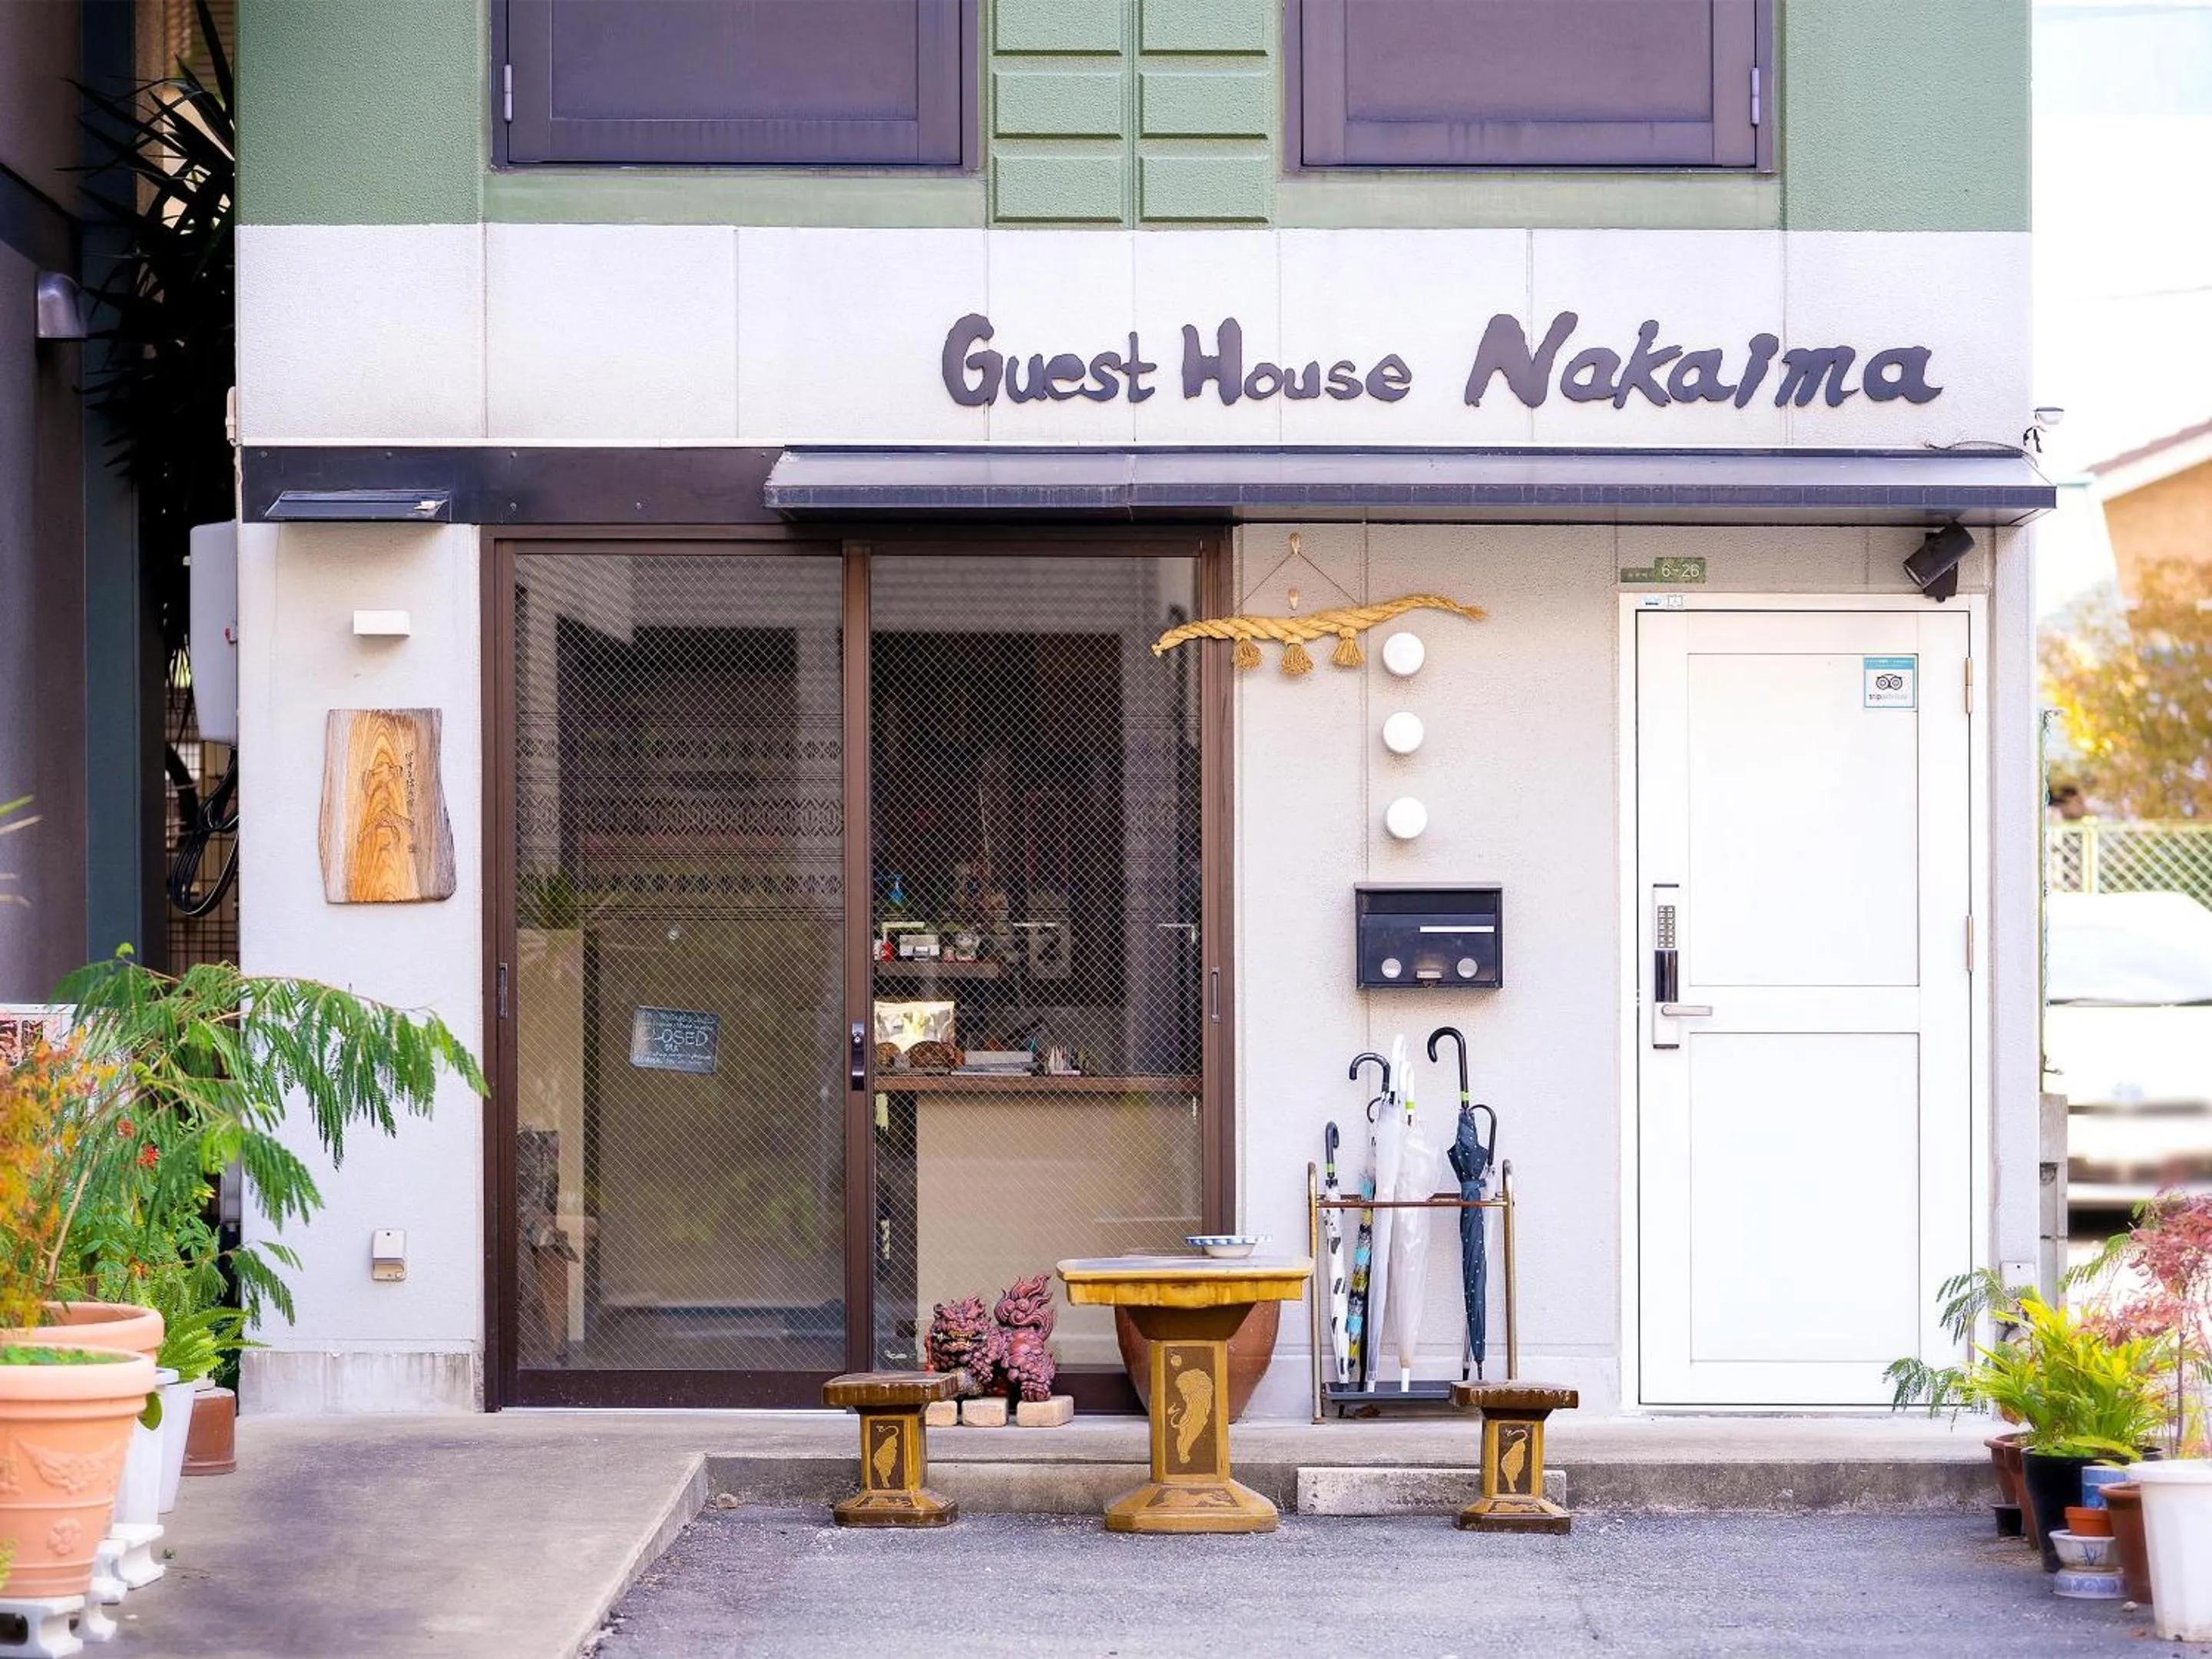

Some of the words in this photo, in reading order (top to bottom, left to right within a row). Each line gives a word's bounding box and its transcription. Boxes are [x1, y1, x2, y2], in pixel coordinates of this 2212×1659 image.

[942, 313, 1157, 406] Guest
[1181, 316, 1413, 406] House
[1464, 310, 1943, 409] Nakaima
[1661, 563, 1700, 578] 6-26
